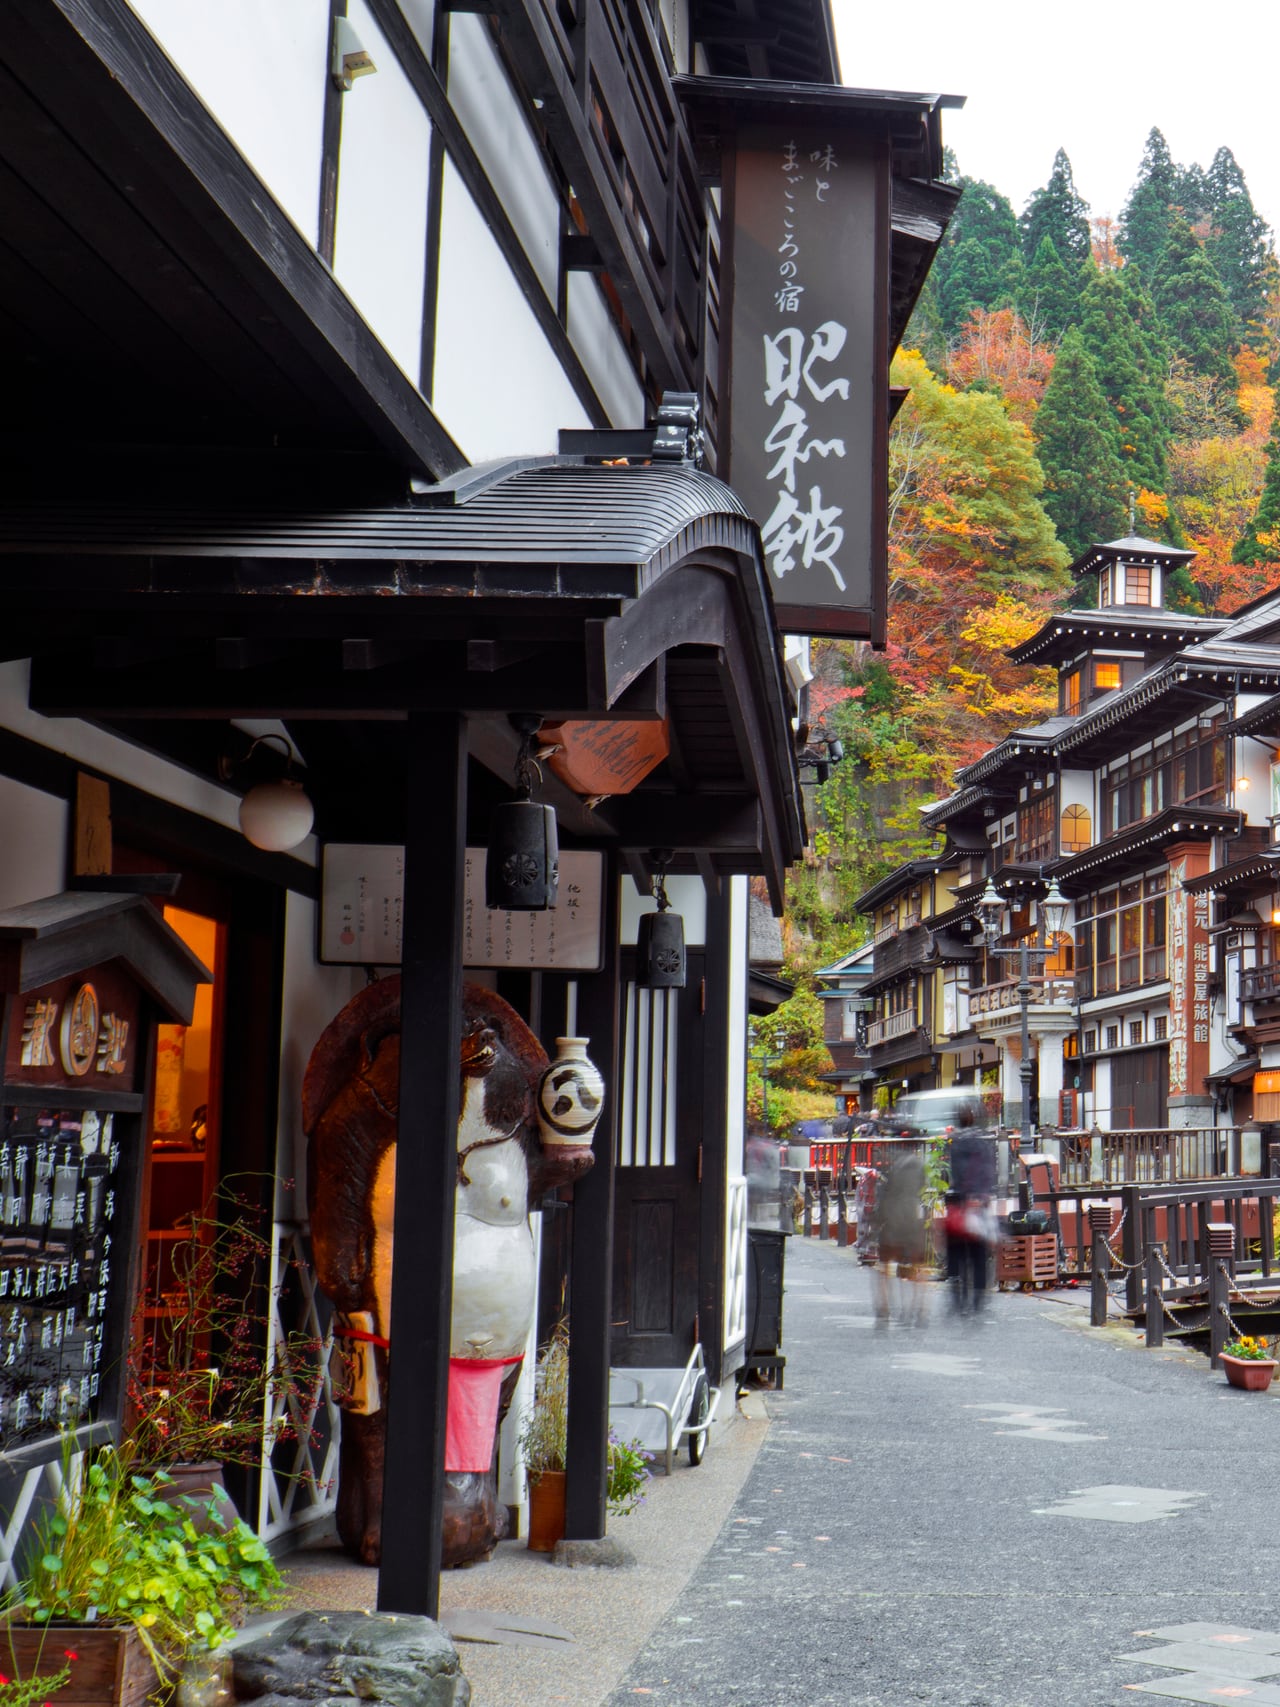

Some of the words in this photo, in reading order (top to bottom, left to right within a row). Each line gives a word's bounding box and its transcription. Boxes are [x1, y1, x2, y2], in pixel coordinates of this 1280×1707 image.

[774, 139, 806, 314] まごころの宿
[808, 143, 838, 203] 味と
[761, 320, 849, 592] 昭和館
[1194, 942, 1208, 1043] 能登屋旅館
